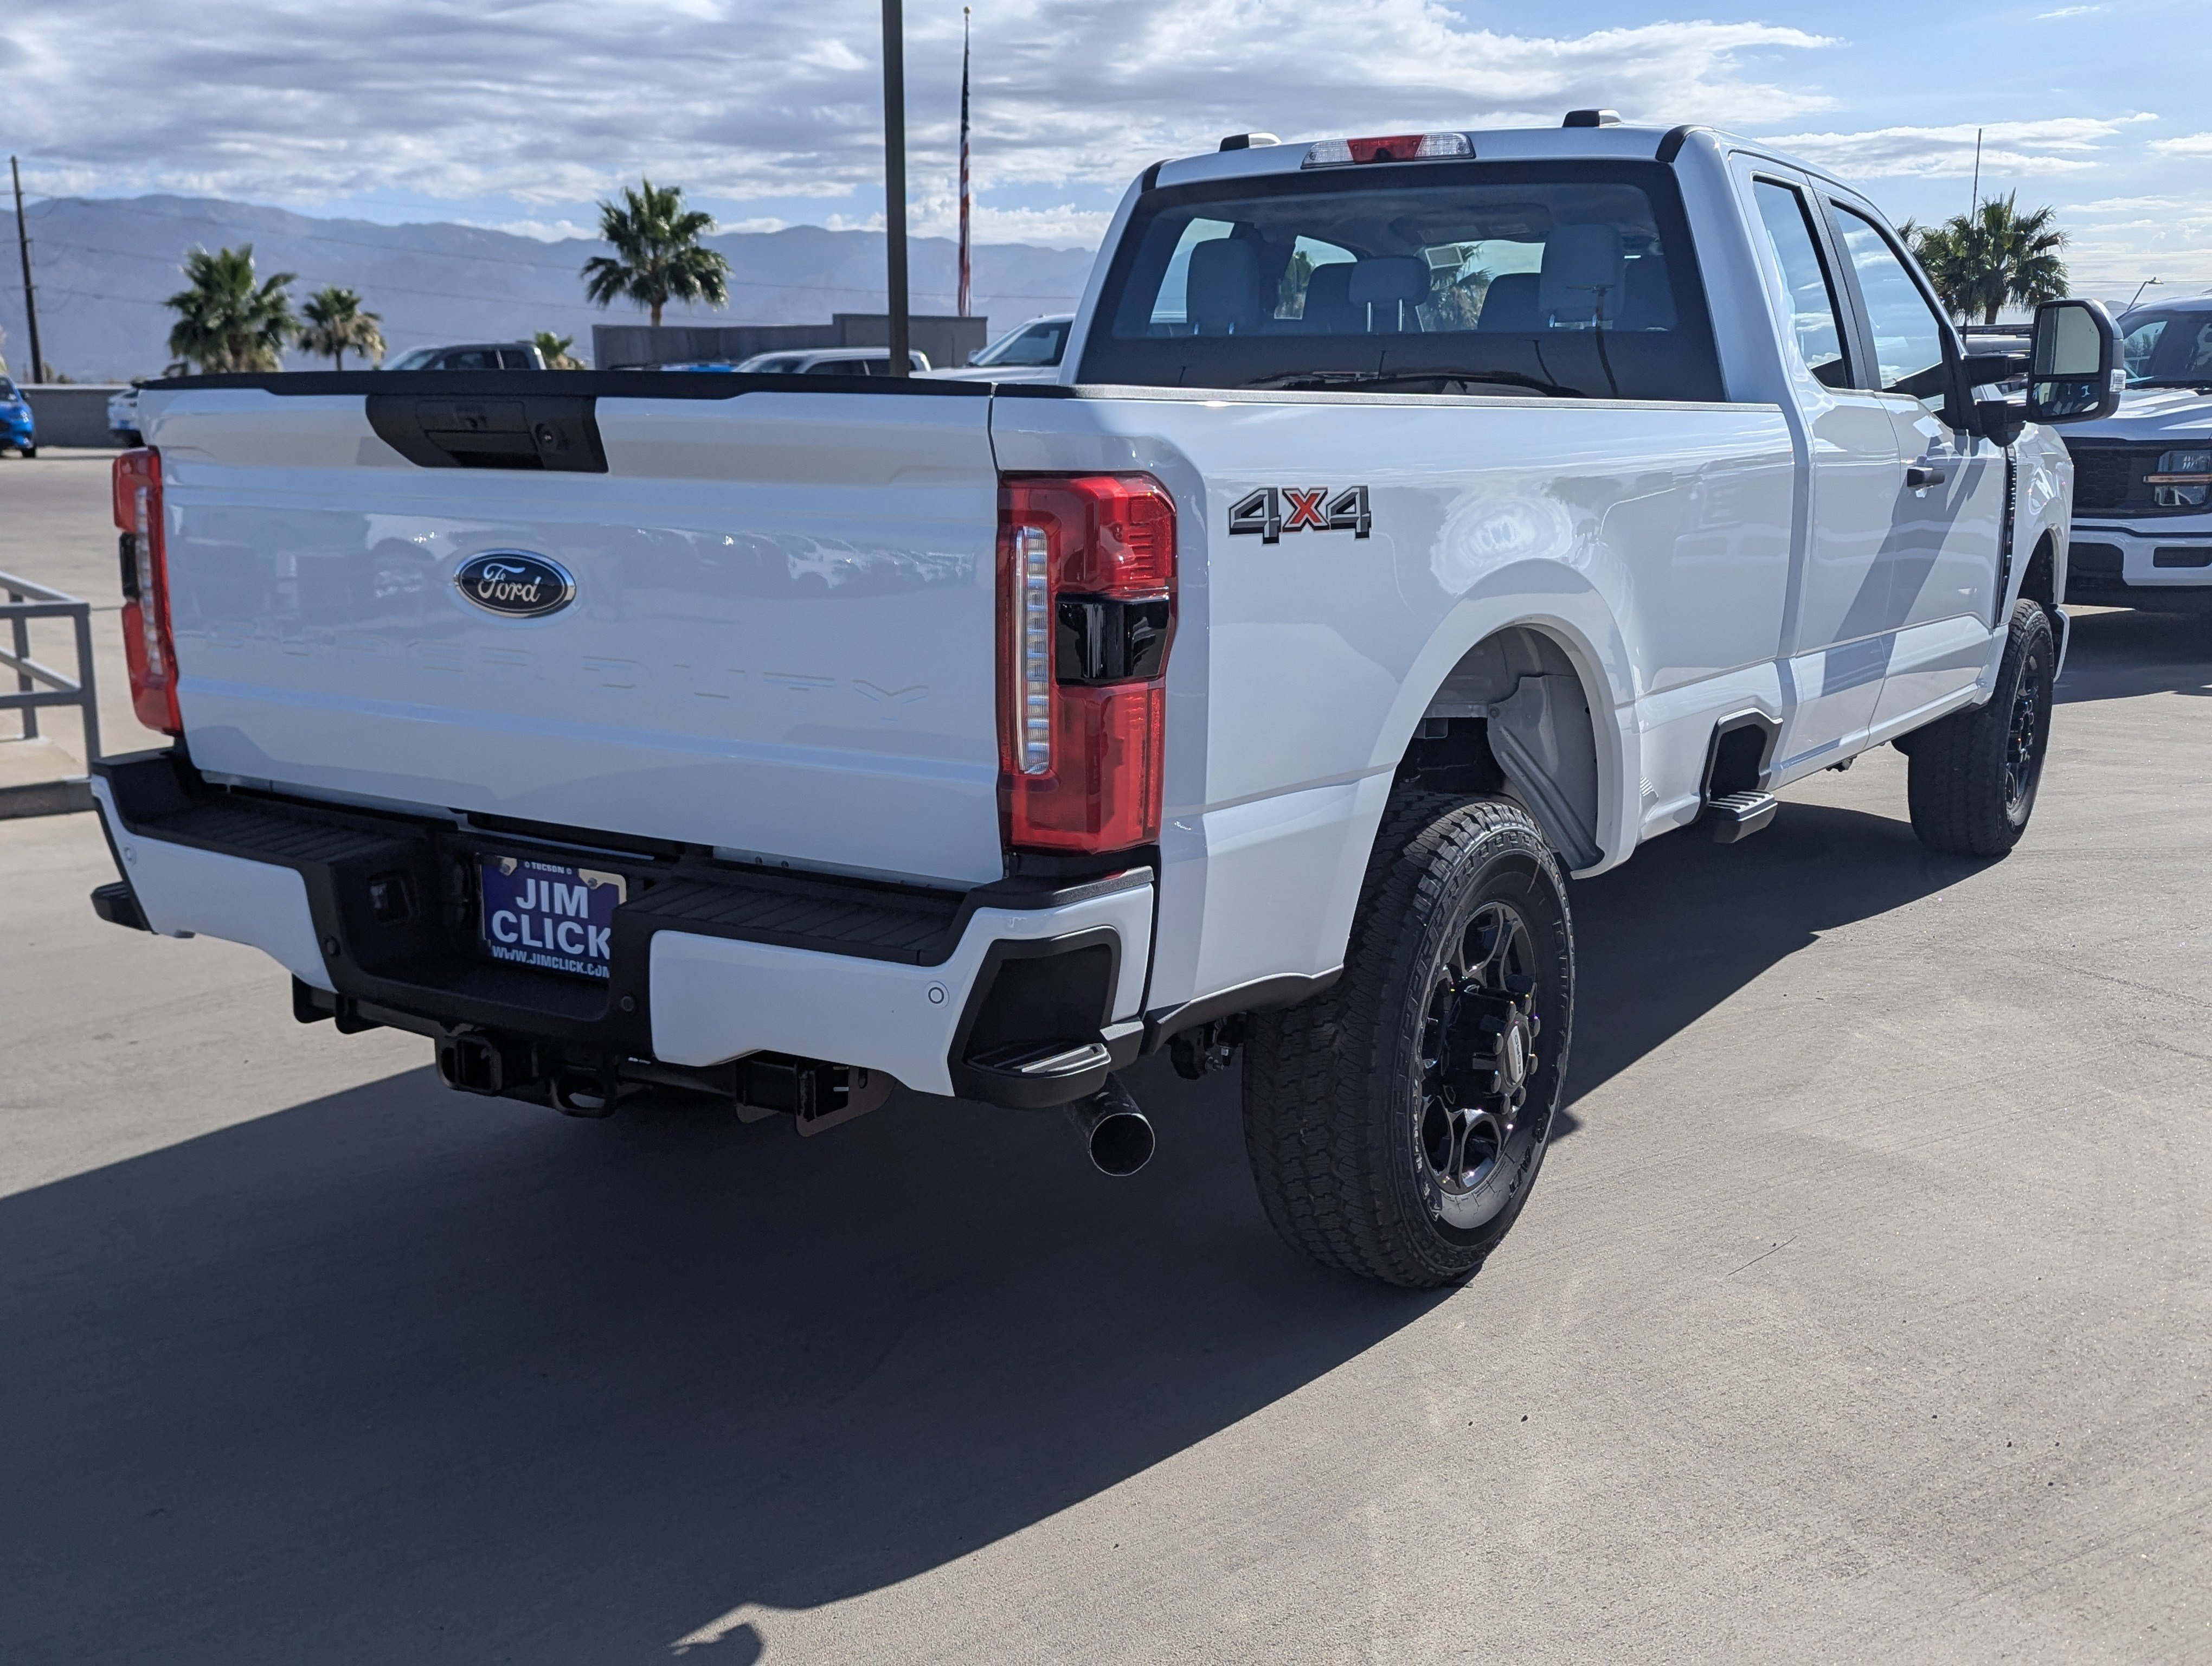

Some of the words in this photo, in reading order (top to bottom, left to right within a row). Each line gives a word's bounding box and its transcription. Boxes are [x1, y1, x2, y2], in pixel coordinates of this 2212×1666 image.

[478, 563, 541, 602] Ford
[531, 861, 565, 874] TUCSON
[516, 878, 588, 919] JIM
[492, 910, 611, 960] CLICK
